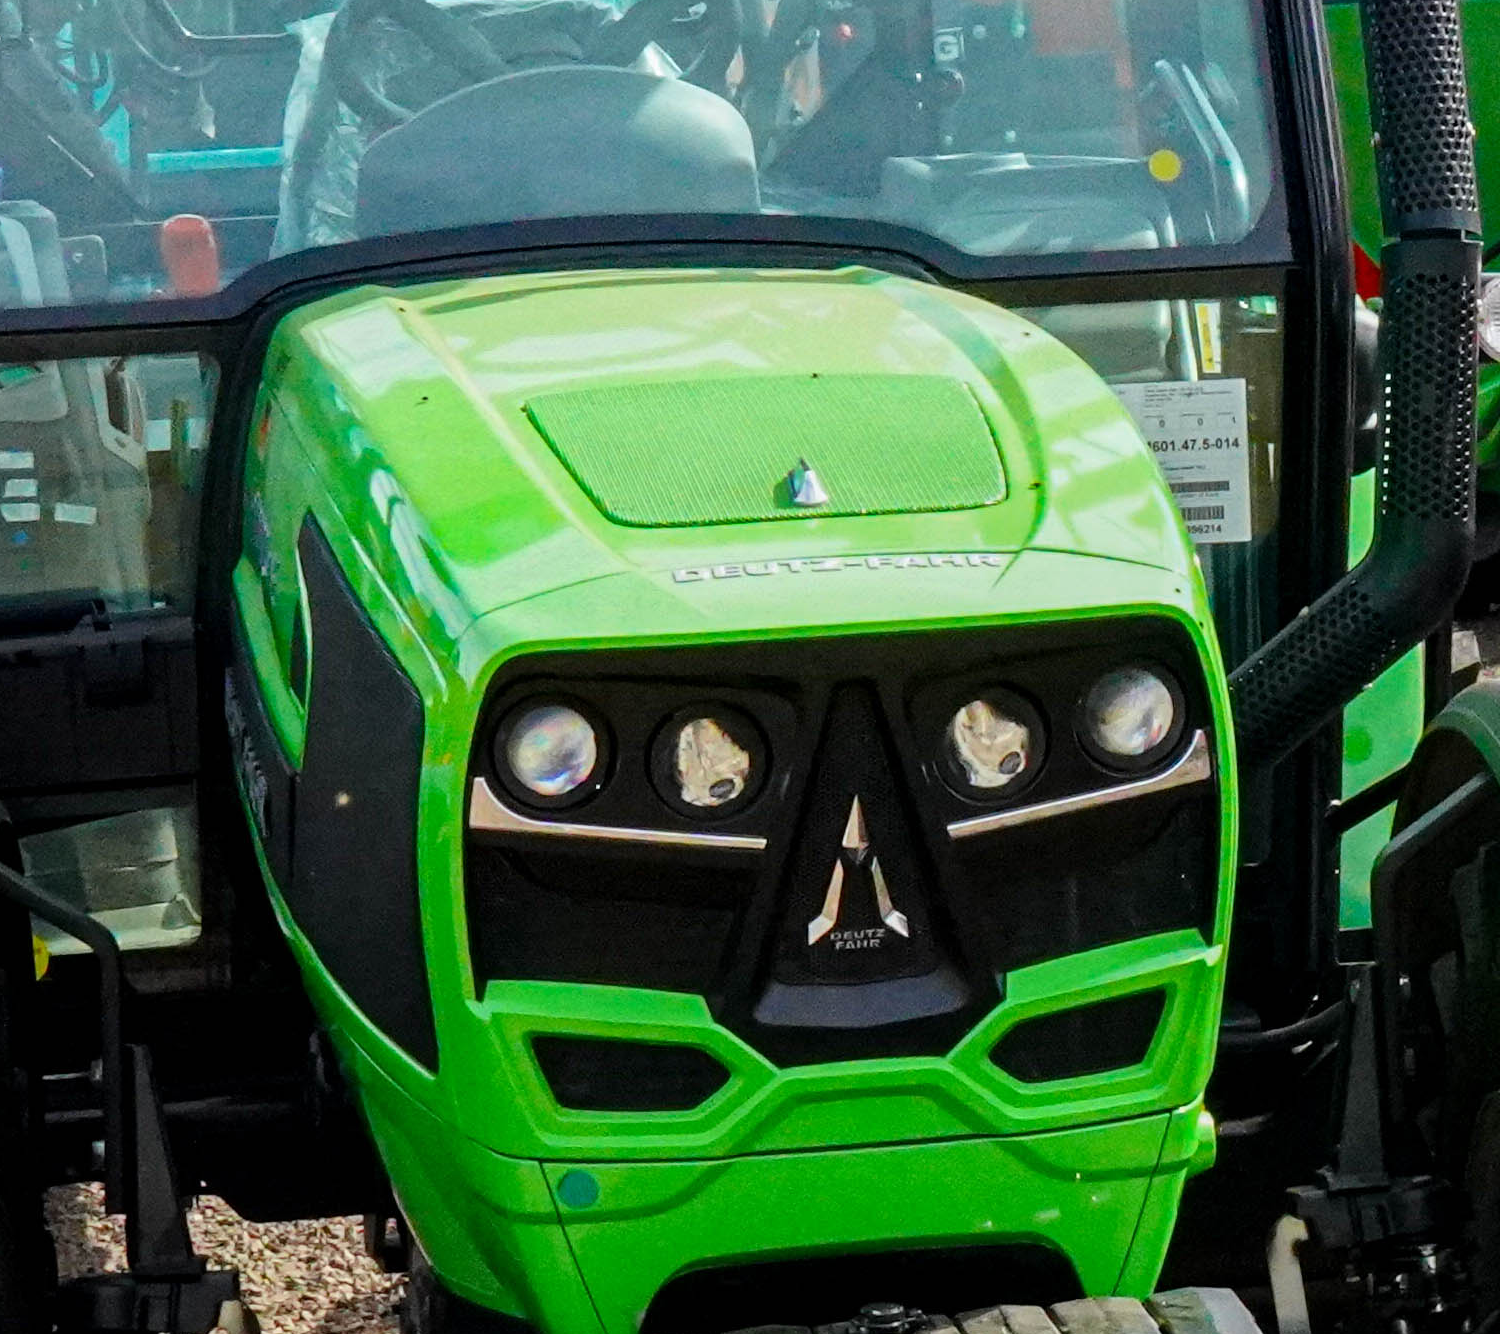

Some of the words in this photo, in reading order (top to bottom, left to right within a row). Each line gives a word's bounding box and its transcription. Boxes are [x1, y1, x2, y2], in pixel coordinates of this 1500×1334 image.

[672, 553, 1003, 583] DEUTZ-FAHR
[830, 928, 886, 940] DEUTZ
[835, 939, 880, 950] FAHR
